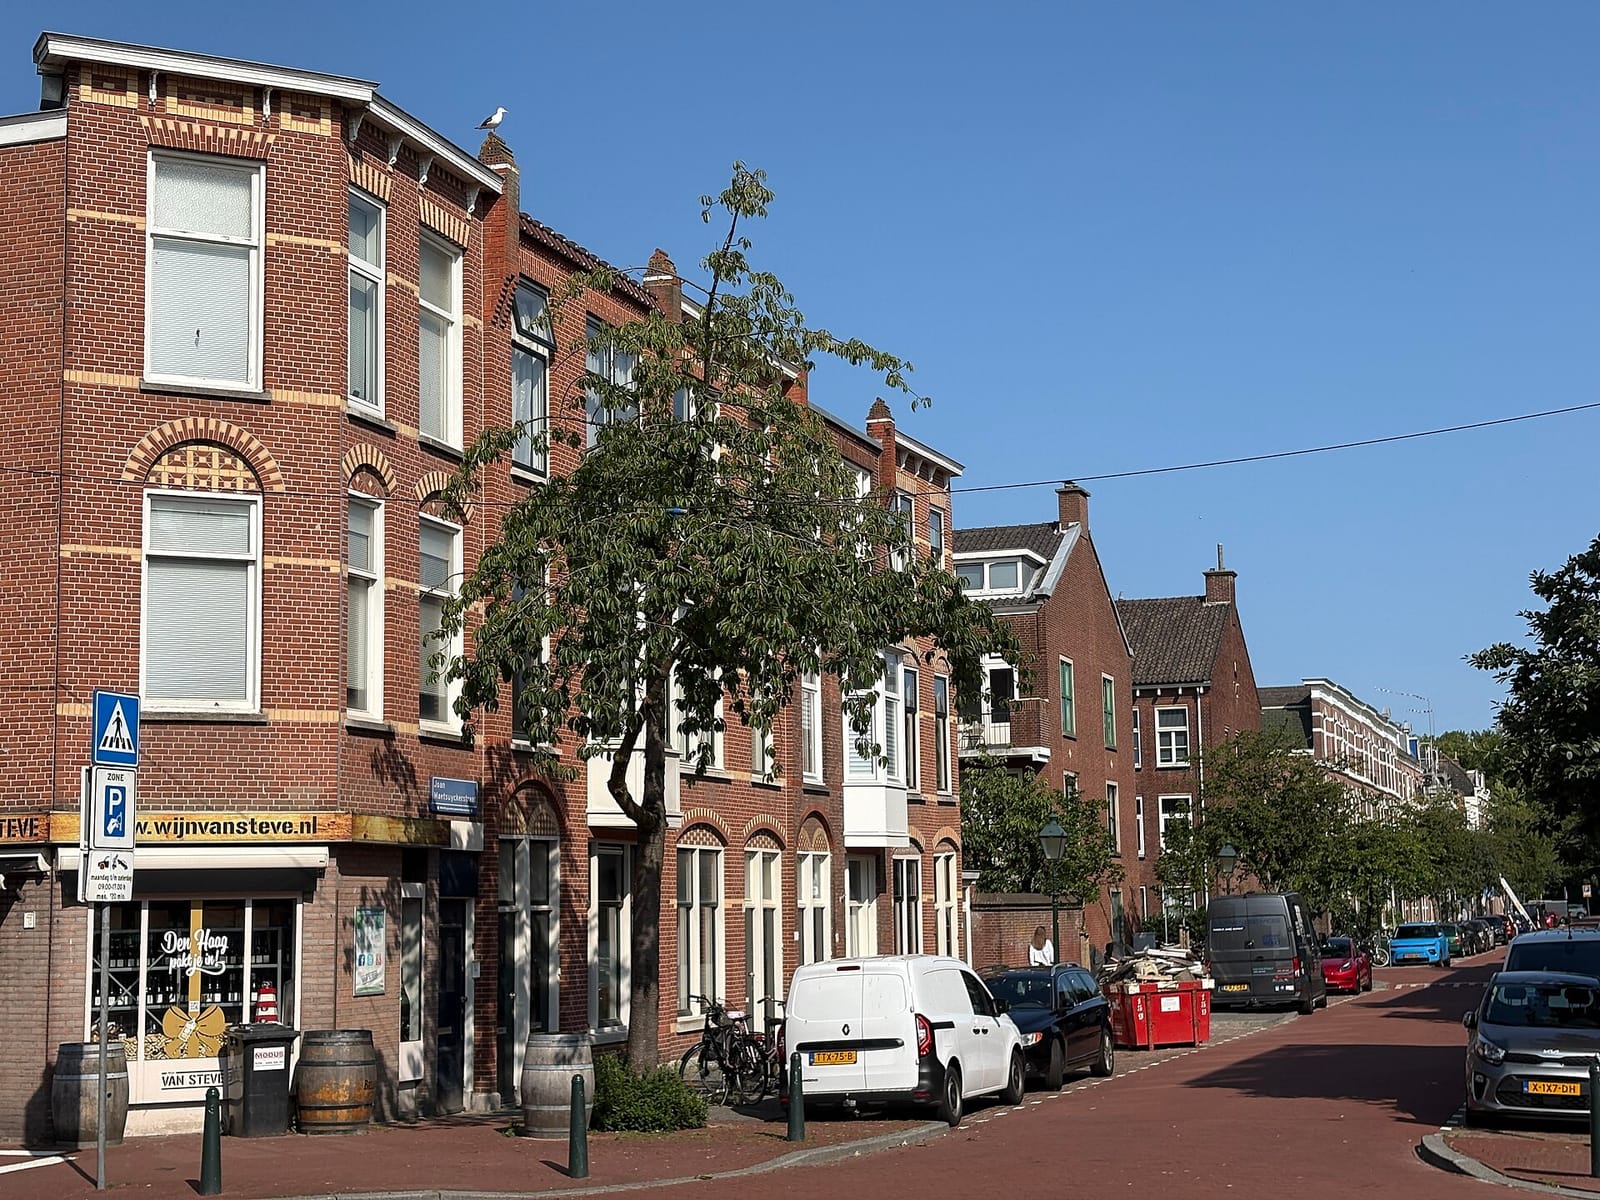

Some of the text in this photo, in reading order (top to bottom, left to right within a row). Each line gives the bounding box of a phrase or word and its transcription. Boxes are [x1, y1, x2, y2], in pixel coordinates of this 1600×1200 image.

[107, 773, 124, 781] ZONE
[161, 928, 229, 955] Den Haag
[168, 951, 192, 975] pakt
[255, 1051, 284, 1060] MODUS
[161, 1073, 224, 1087] VAN STEVE
[1532, 1083, 1576, 1094] X-1X7-DH
